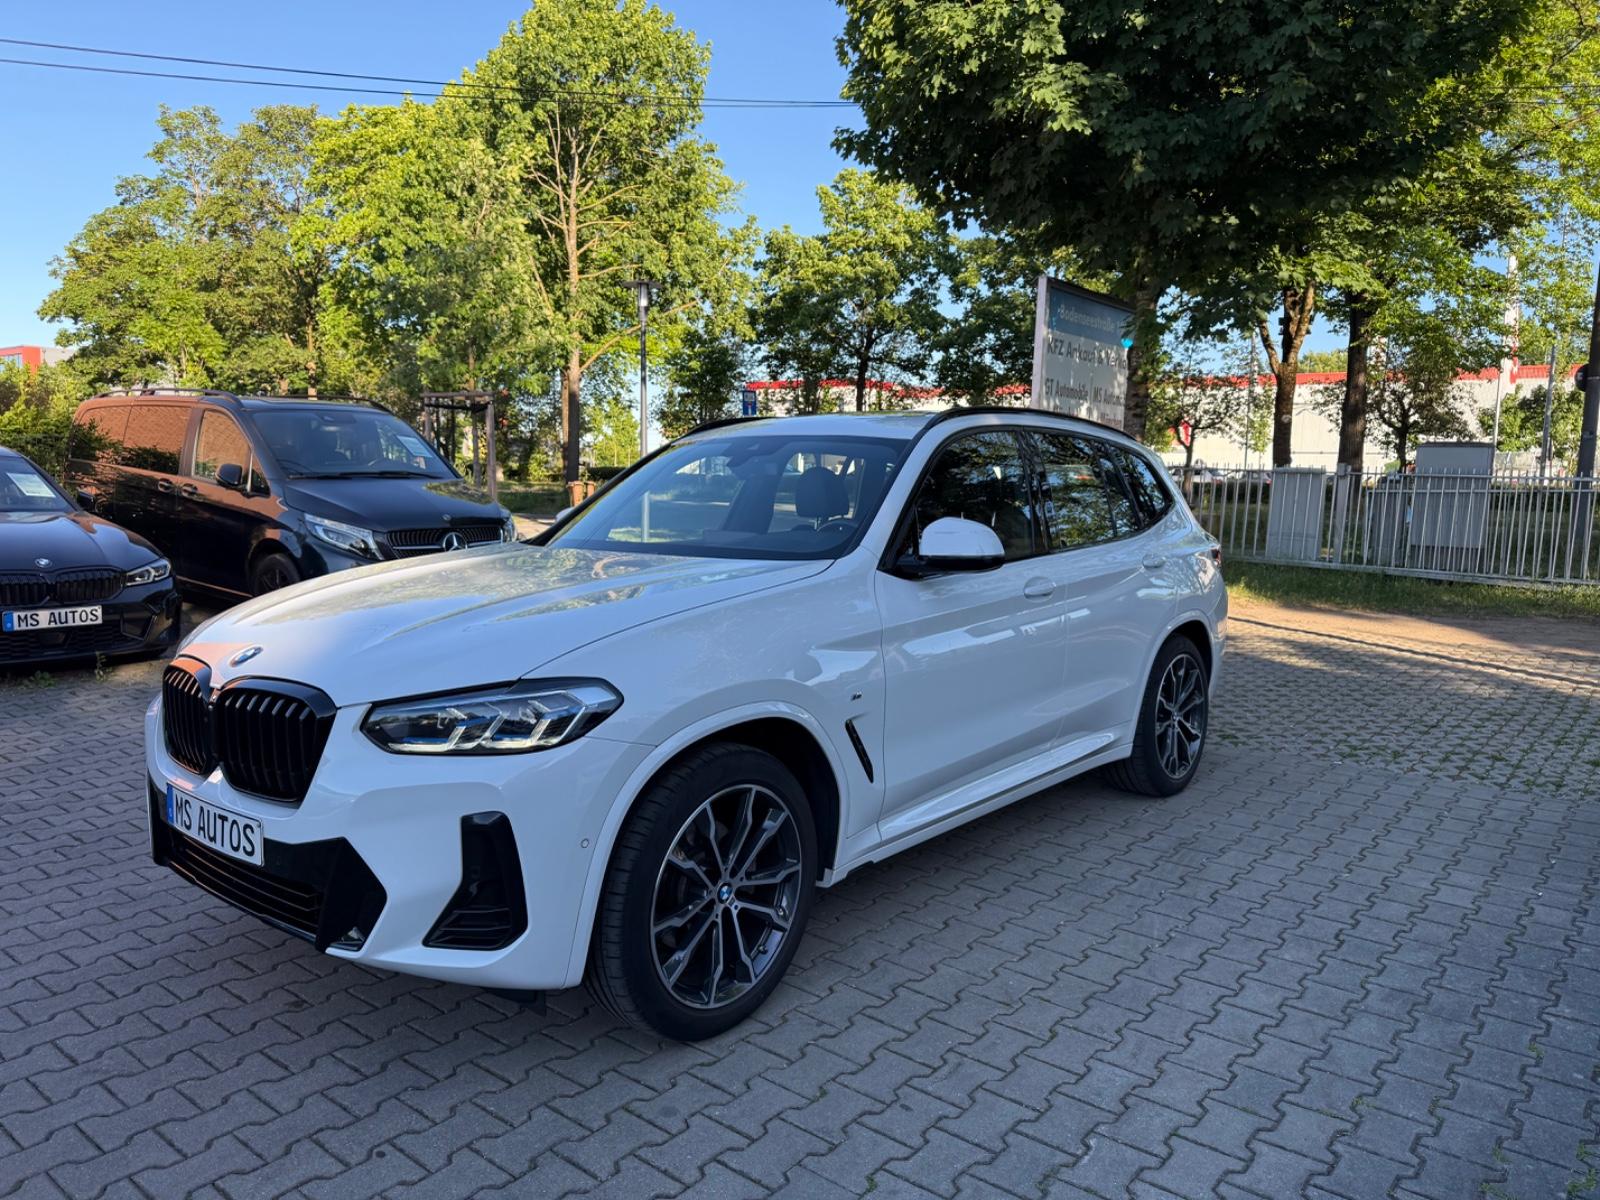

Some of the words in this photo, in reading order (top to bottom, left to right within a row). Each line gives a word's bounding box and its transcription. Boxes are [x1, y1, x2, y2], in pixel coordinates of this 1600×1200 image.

[17, 612, 40, 628] MS
[47, 608, 99, 626] AUTOS
[175, 794, 192, 831] MS
[198, 805, 255, 857] AUTOS
